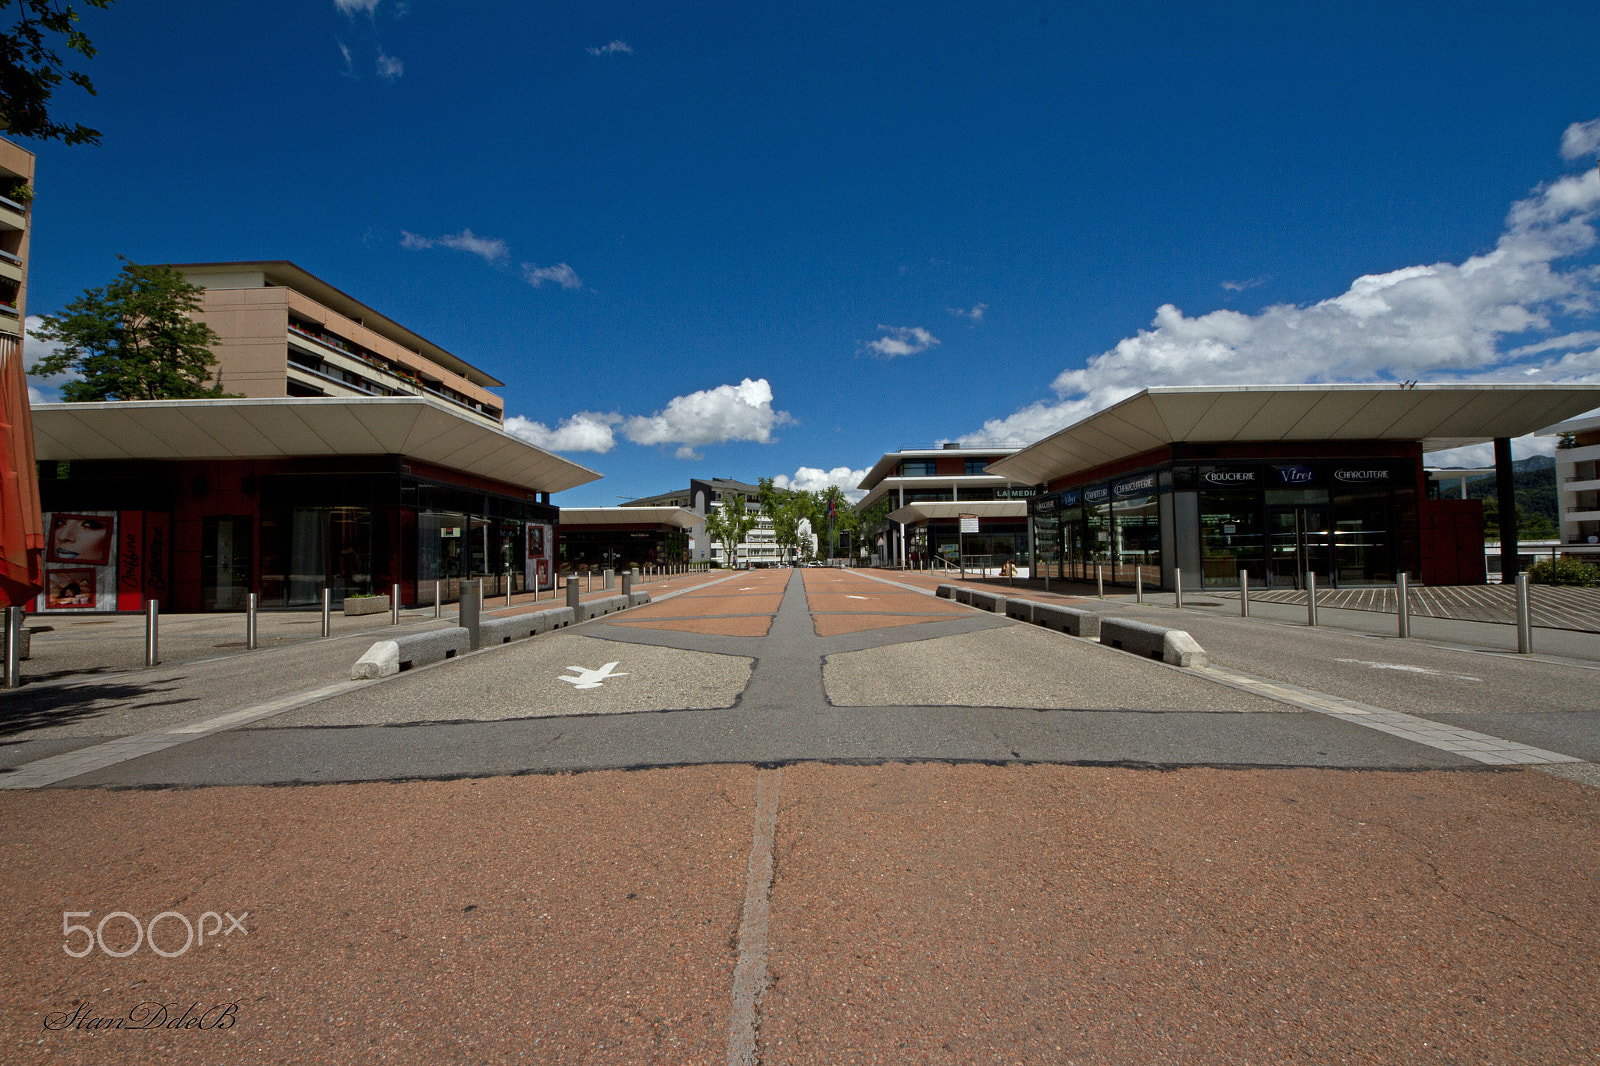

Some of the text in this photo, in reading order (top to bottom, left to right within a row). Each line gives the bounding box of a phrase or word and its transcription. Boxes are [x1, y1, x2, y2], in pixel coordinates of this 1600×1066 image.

[1209, 471, 1256, 481] BOUCHERIE
[1337, 469, 1390, 480] CHARCUTERIE
[1116, 477, 1154, 493] CHARCUTERIE
